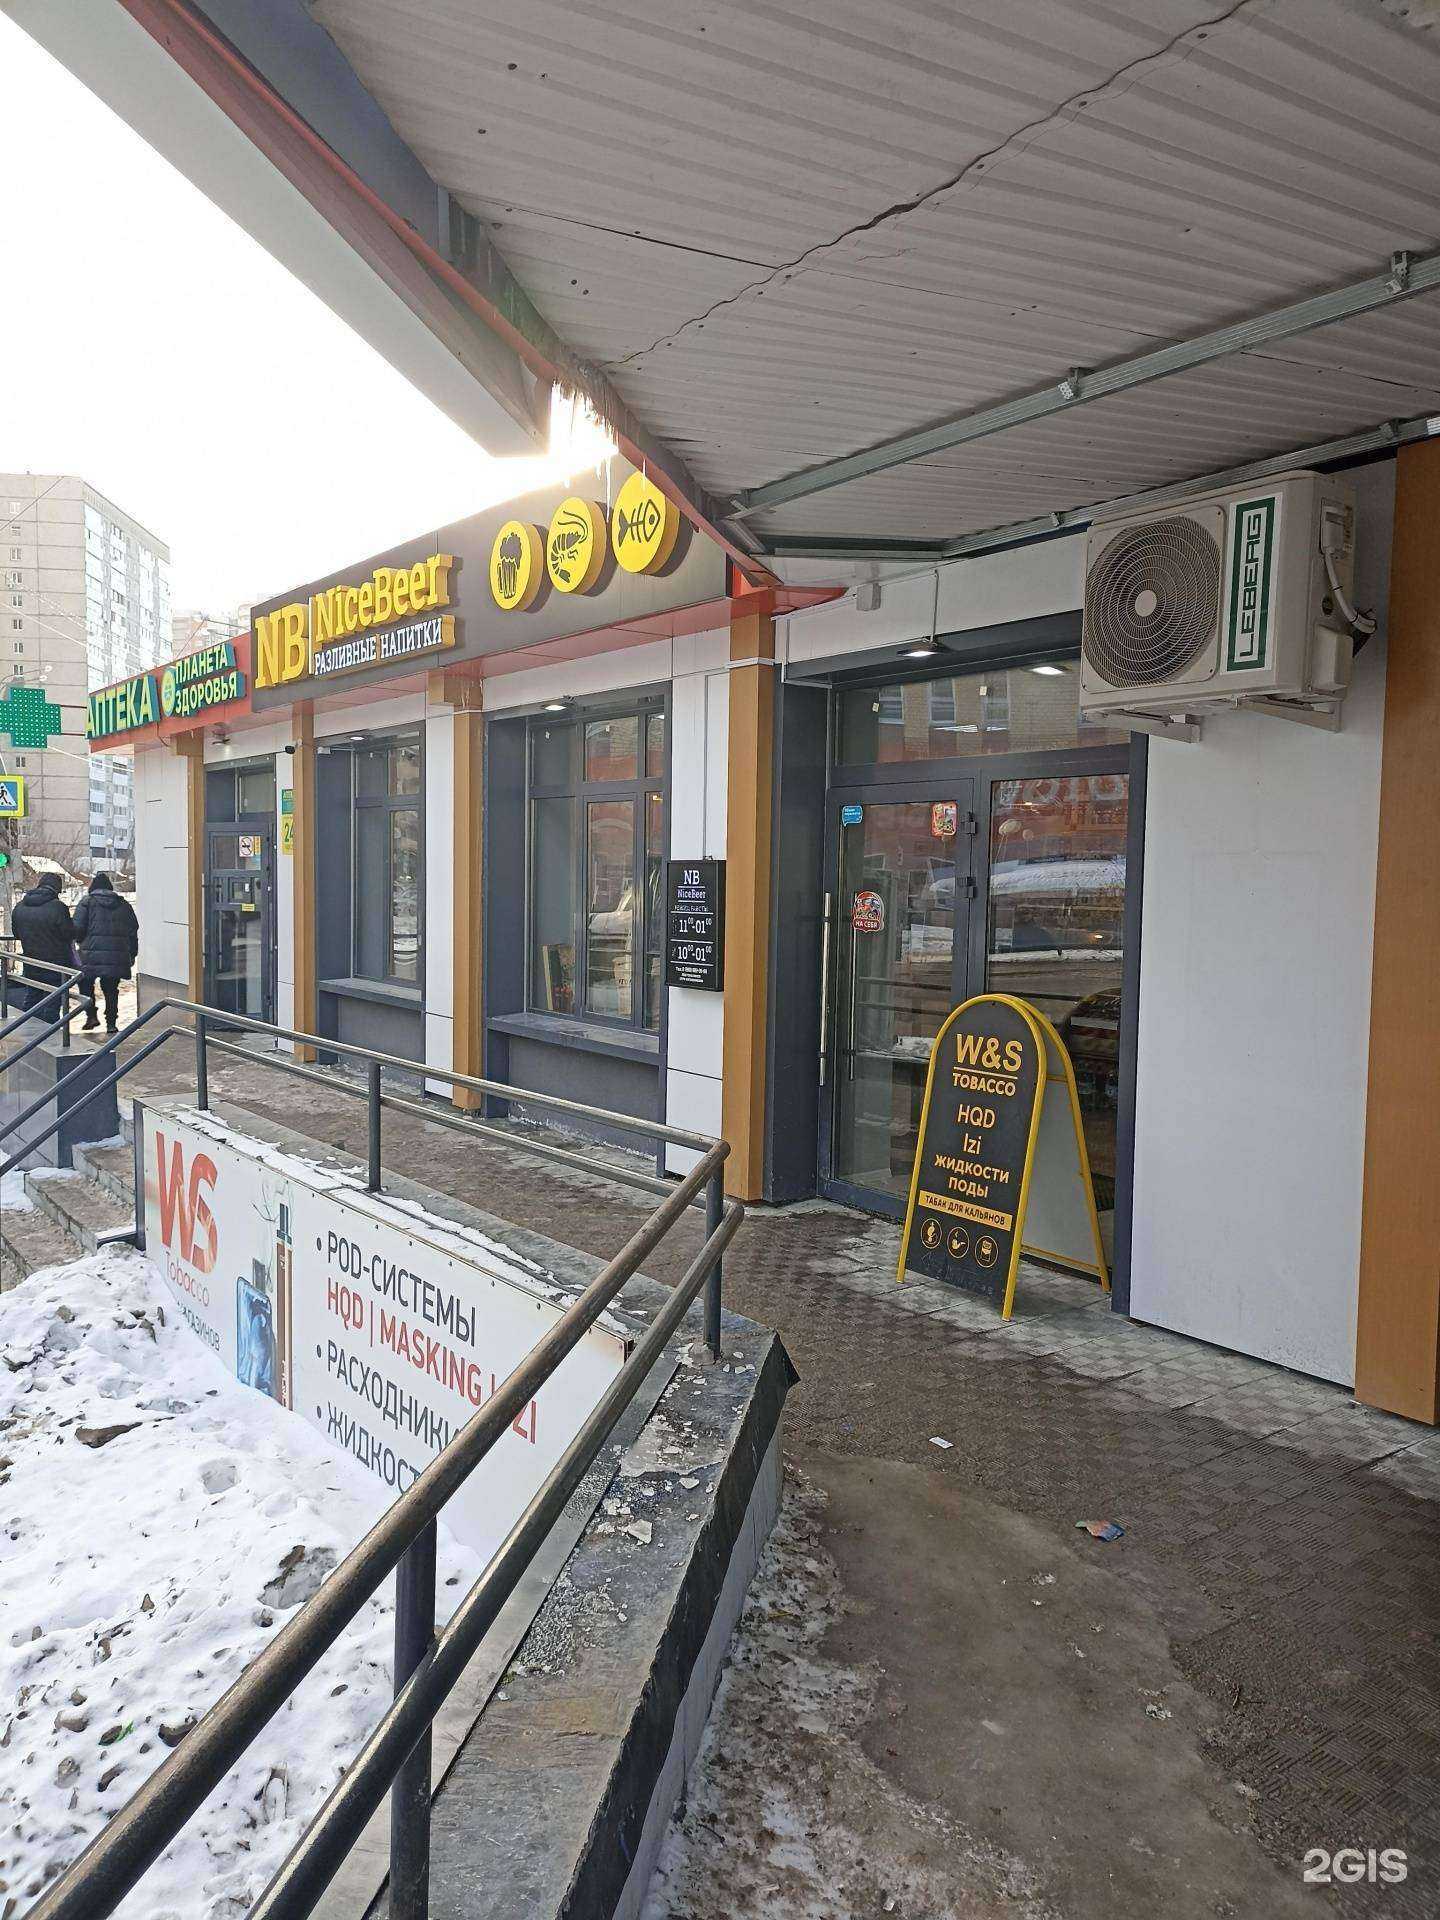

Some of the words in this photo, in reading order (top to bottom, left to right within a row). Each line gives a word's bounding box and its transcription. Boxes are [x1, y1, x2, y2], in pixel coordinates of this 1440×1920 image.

[315, 556, 440, 641] NiceBeer
[1240, 513, 1262, 657] LEBERG
[175, 644, 228, 683] ПЛАНЕТА
[254, 602, 306, 688] NB
[314, 636, 377, 675] РАЗЛИВНЫЕ
[380, 617, 442, 659] НАПИТКИ
[86, 675, 153, 738] АПТЕКА
[175, 672, 237, 716] ЗДОРОВЬЯ
[684, 870, 700, 884] NB
[956, 1033, 1023, 1072] W&S
[952, 1073, 1016, 1097] TOBACCO
[957, 1104, 996, 1129] HQD
[934, 1154, 1010, 1184] ЖИДКОСТИ
[948, 1176, 989, 1199] ПОДЫ
[925, 1195, 946, 1209] ТАБАК
[948, 1201, 964, 1212] ДЛЯ
[964, 1204, 1006, 1226] КАЛЬЯНОВ
[328, 1231, 476, 1347] POD-СИСТЕМЫ
[327, 1277, 364, 1330] HQD
[380, 1309, 482, 1406] MASKING
[512, 1400, 537, 1445] ZI
